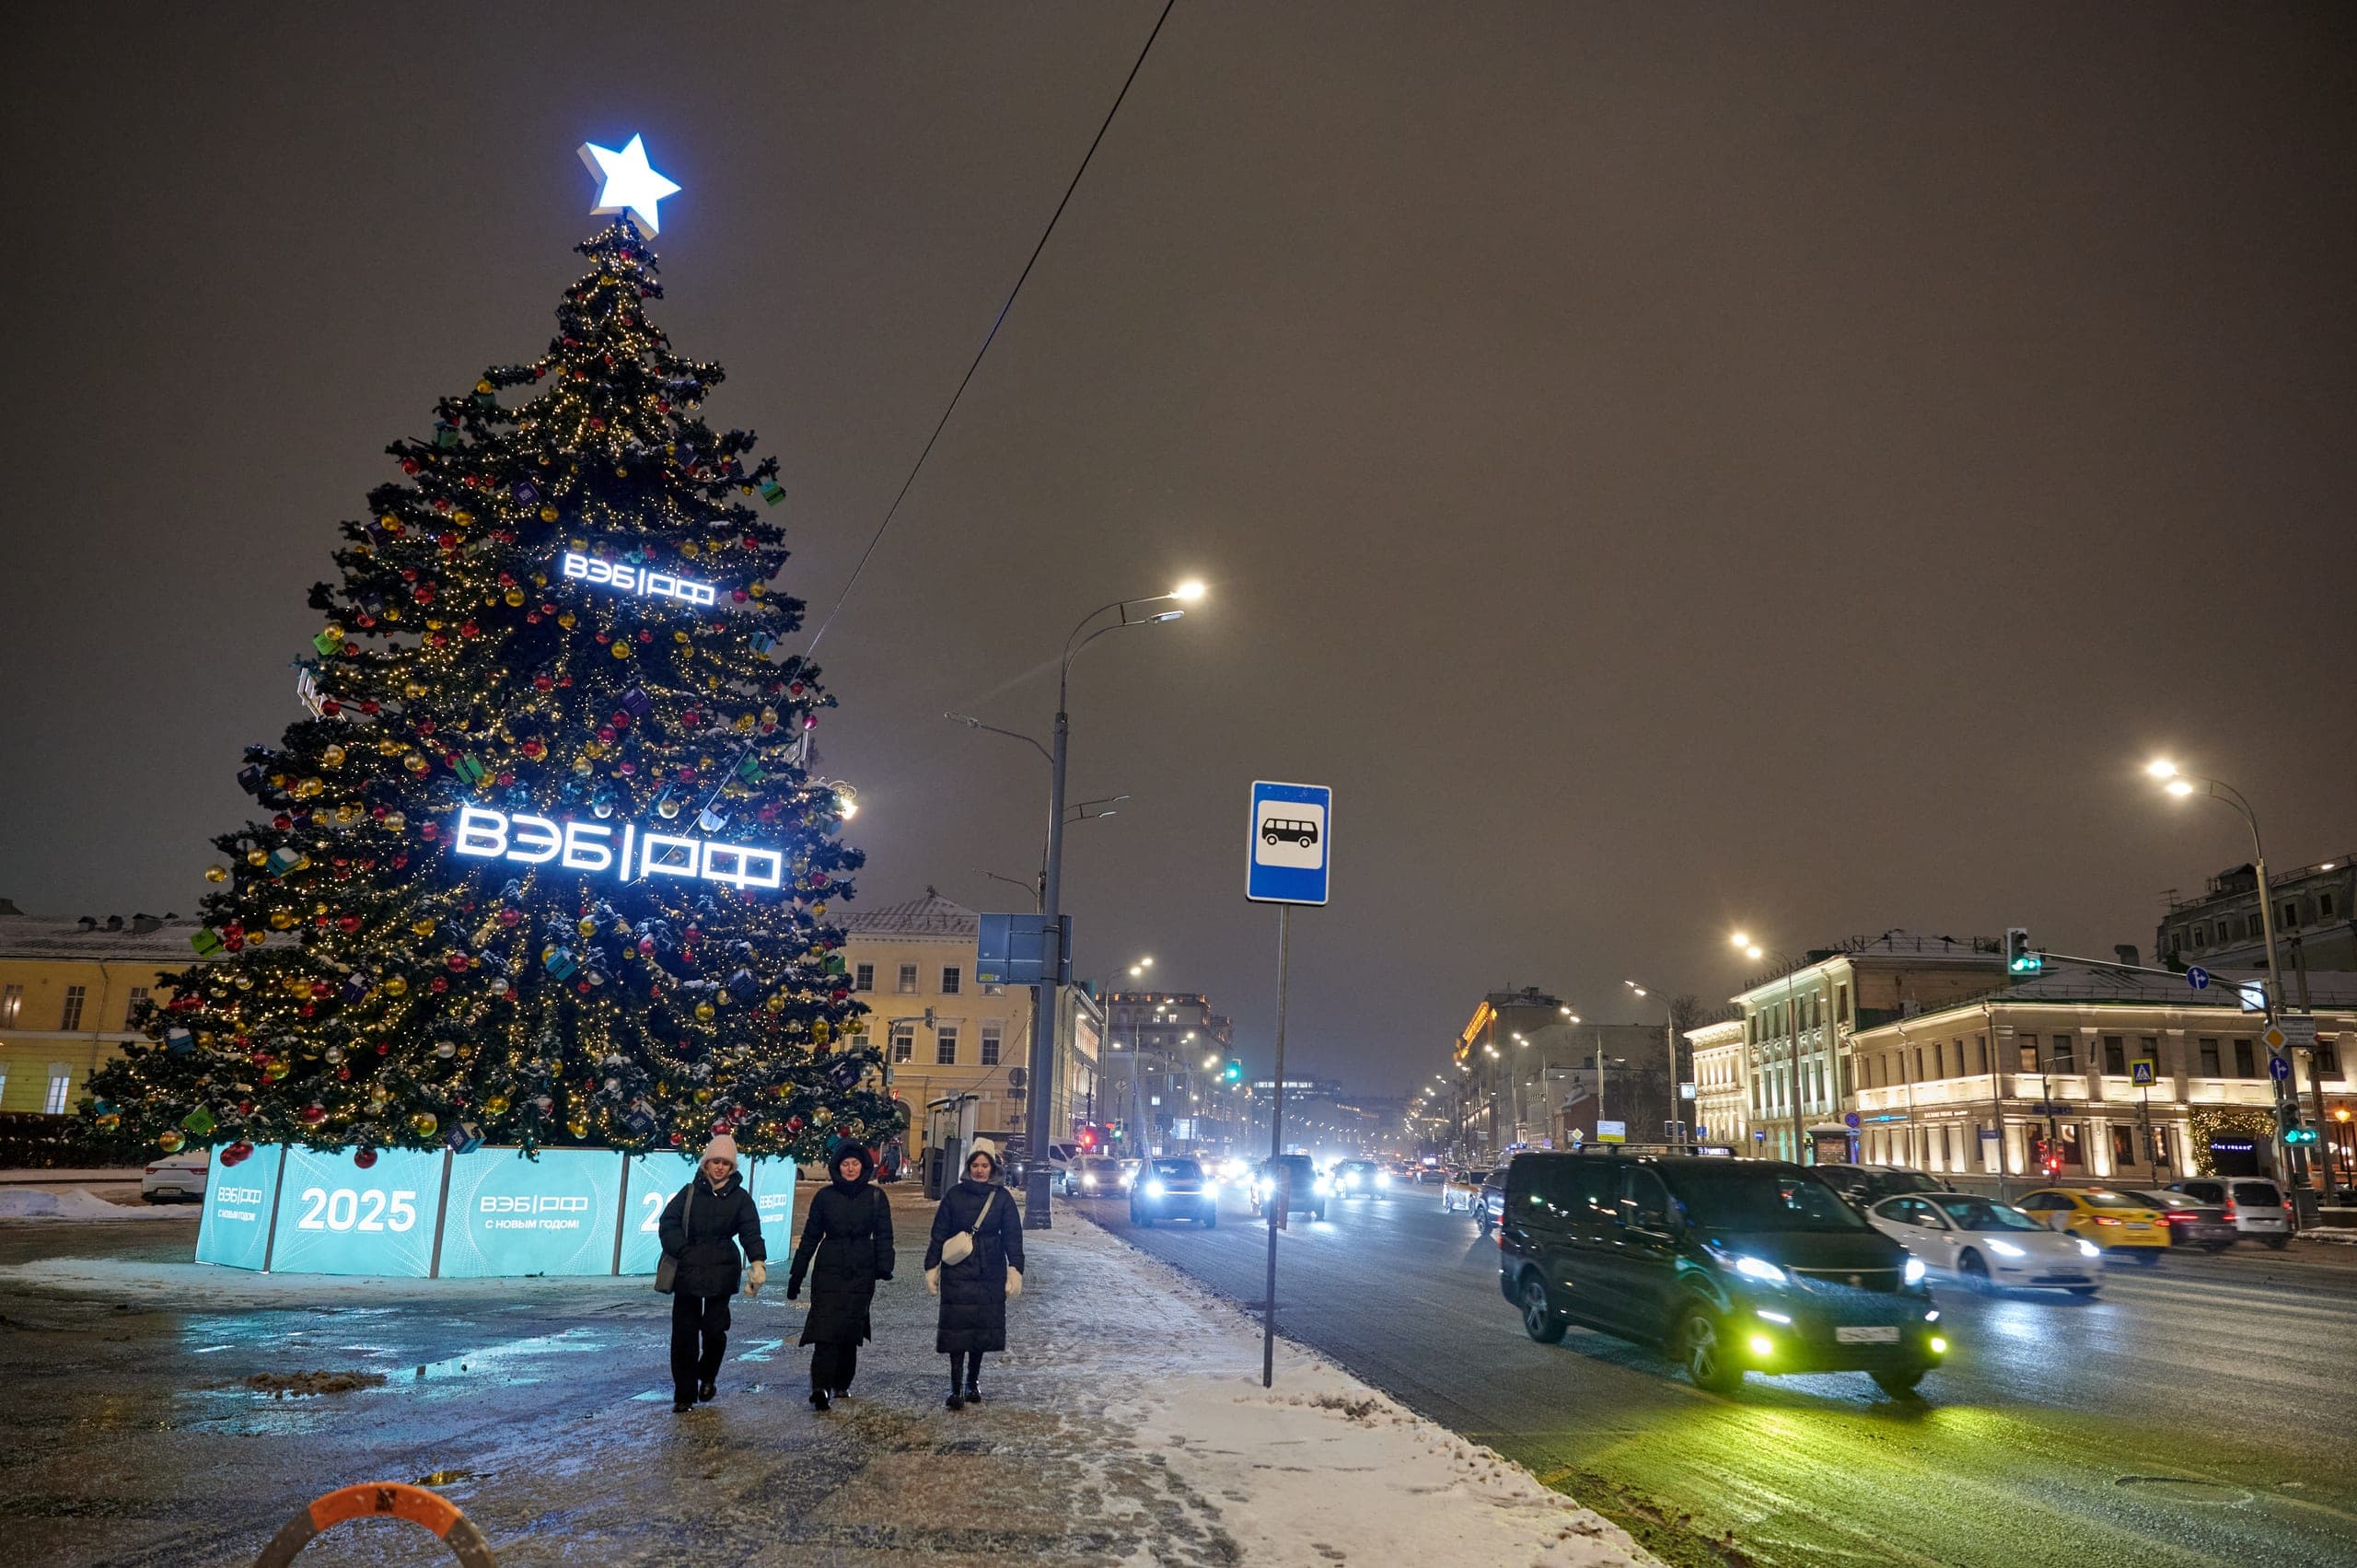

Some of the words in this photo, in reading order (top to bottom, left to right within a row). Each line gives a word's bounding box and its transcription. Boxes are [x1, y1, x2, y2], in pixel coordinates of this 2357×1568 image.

[297, 1187, 417, 1232] 2025
[485, 1220, 493, 1229] С
[495, 1220, 537, 1229] НОВЫМ
[539, 1220, 580, 1230] ГОДОМ!
